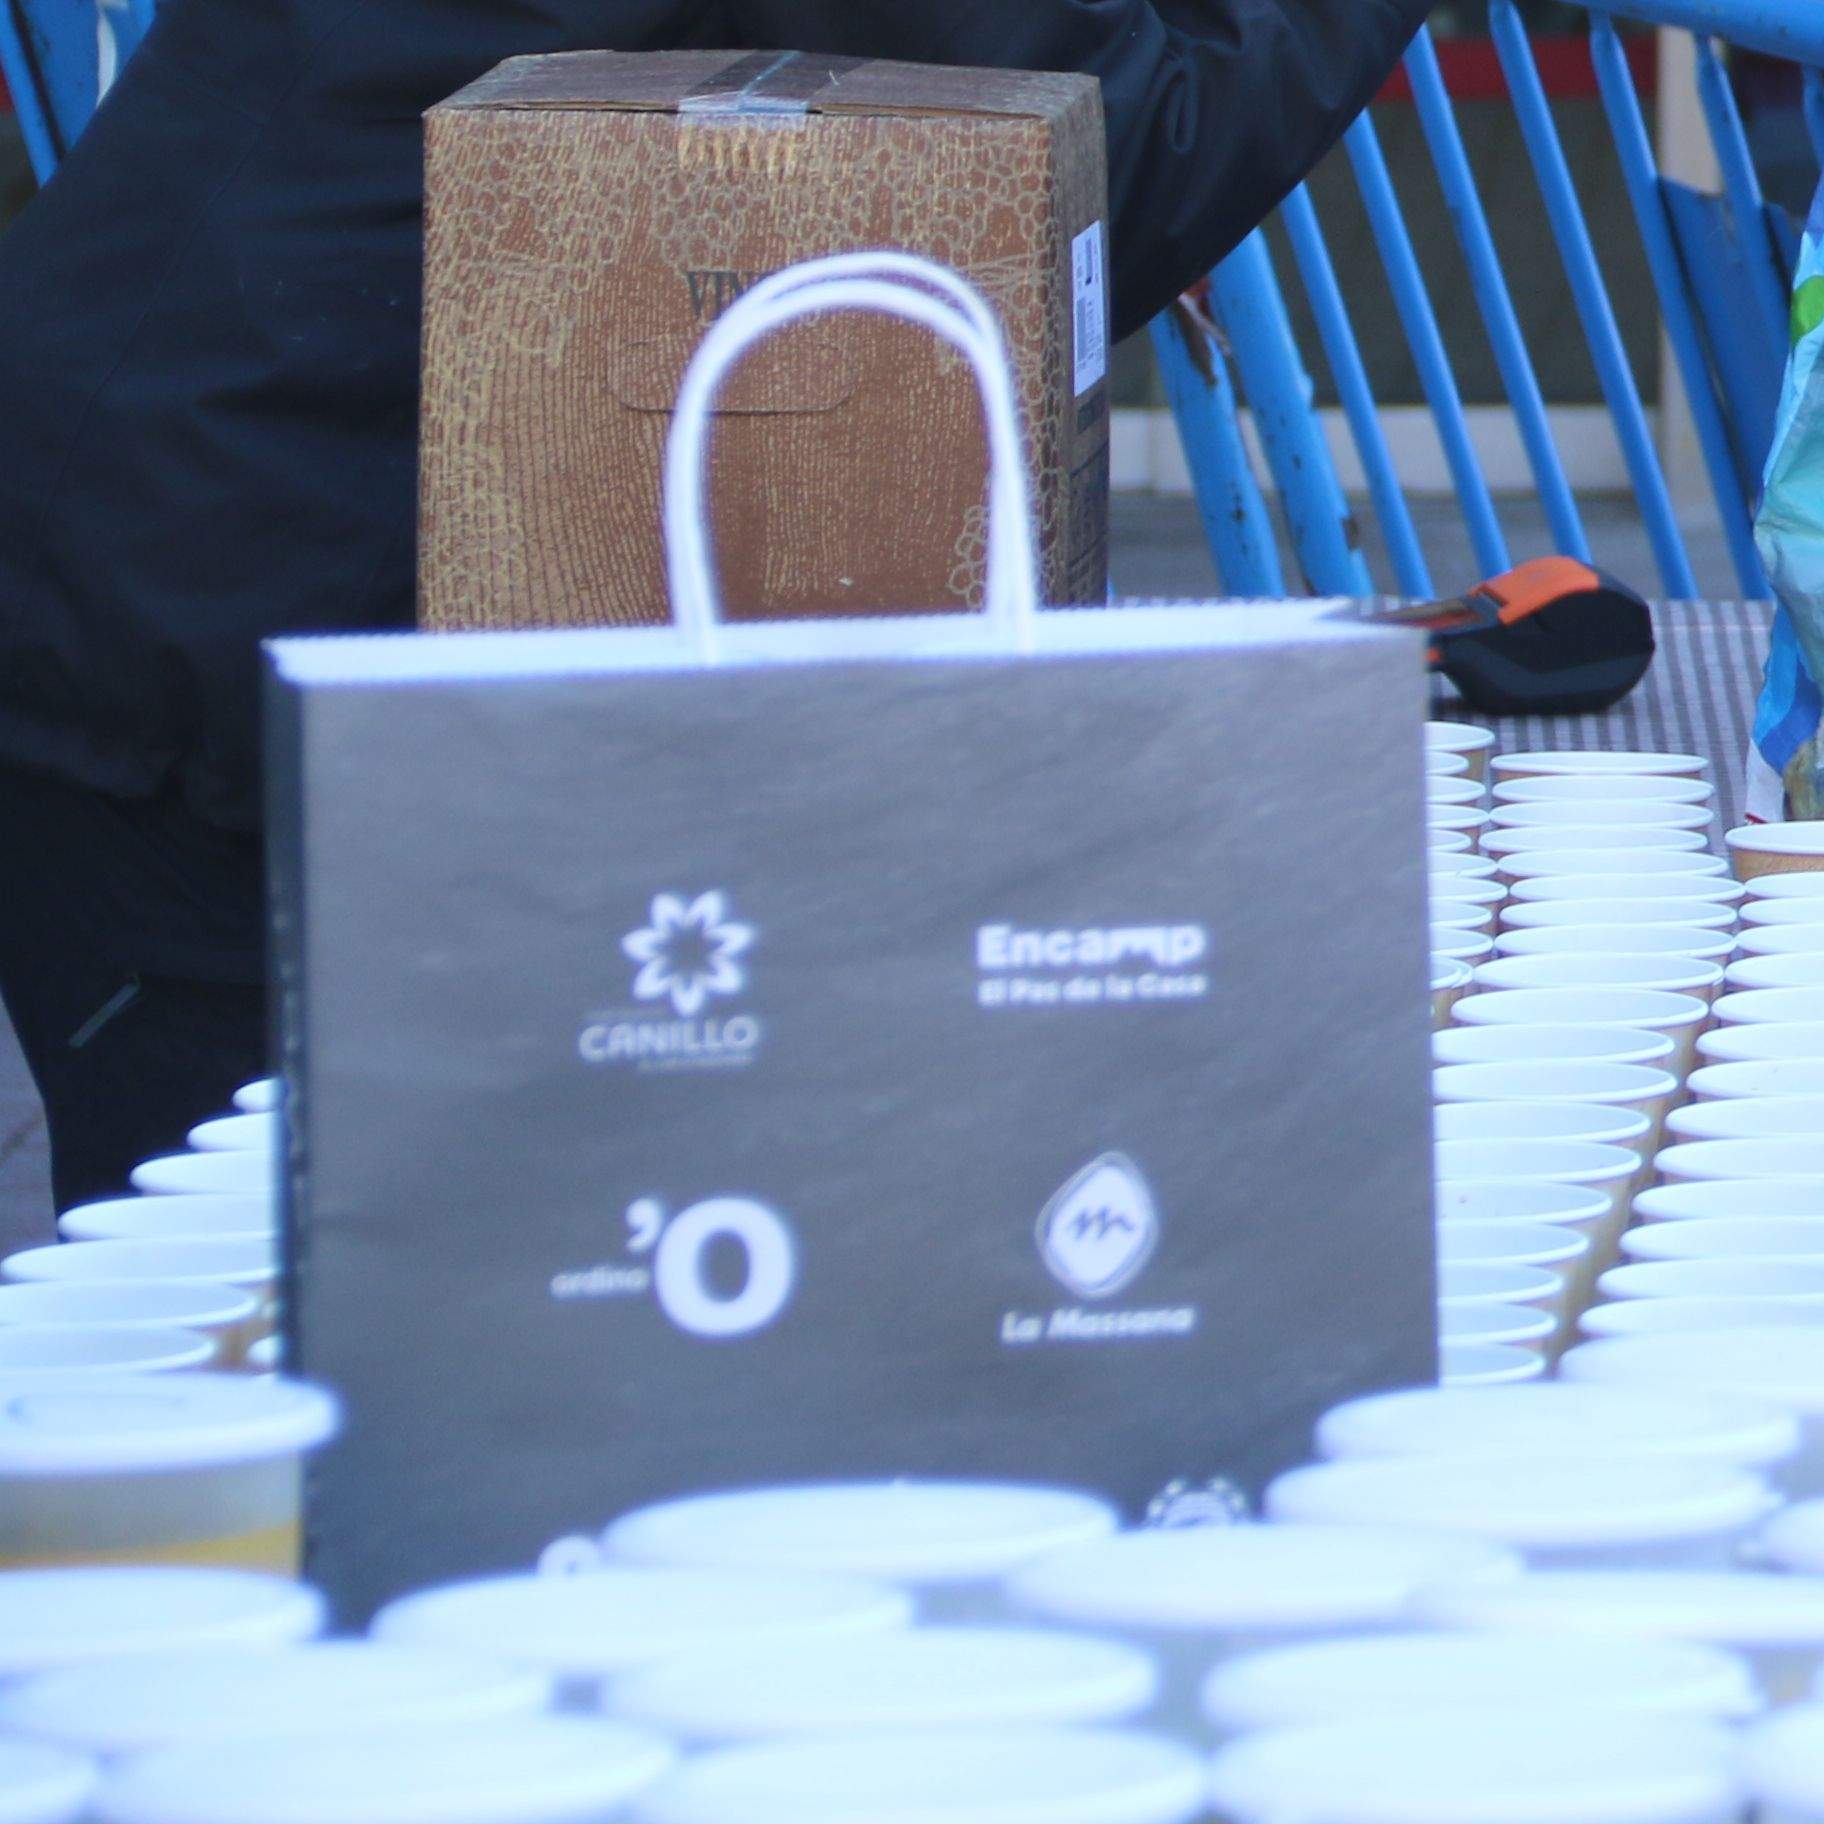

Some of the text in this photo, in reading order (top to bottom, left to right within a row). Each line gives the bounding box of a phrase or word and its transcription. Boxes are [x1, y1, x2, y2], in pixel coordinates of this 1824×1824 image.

[977, 923, 1206, 970] Encamp
[579, 1016, 758, 1062] CANILLO
[1001, 1311, 1042, 1343] La
